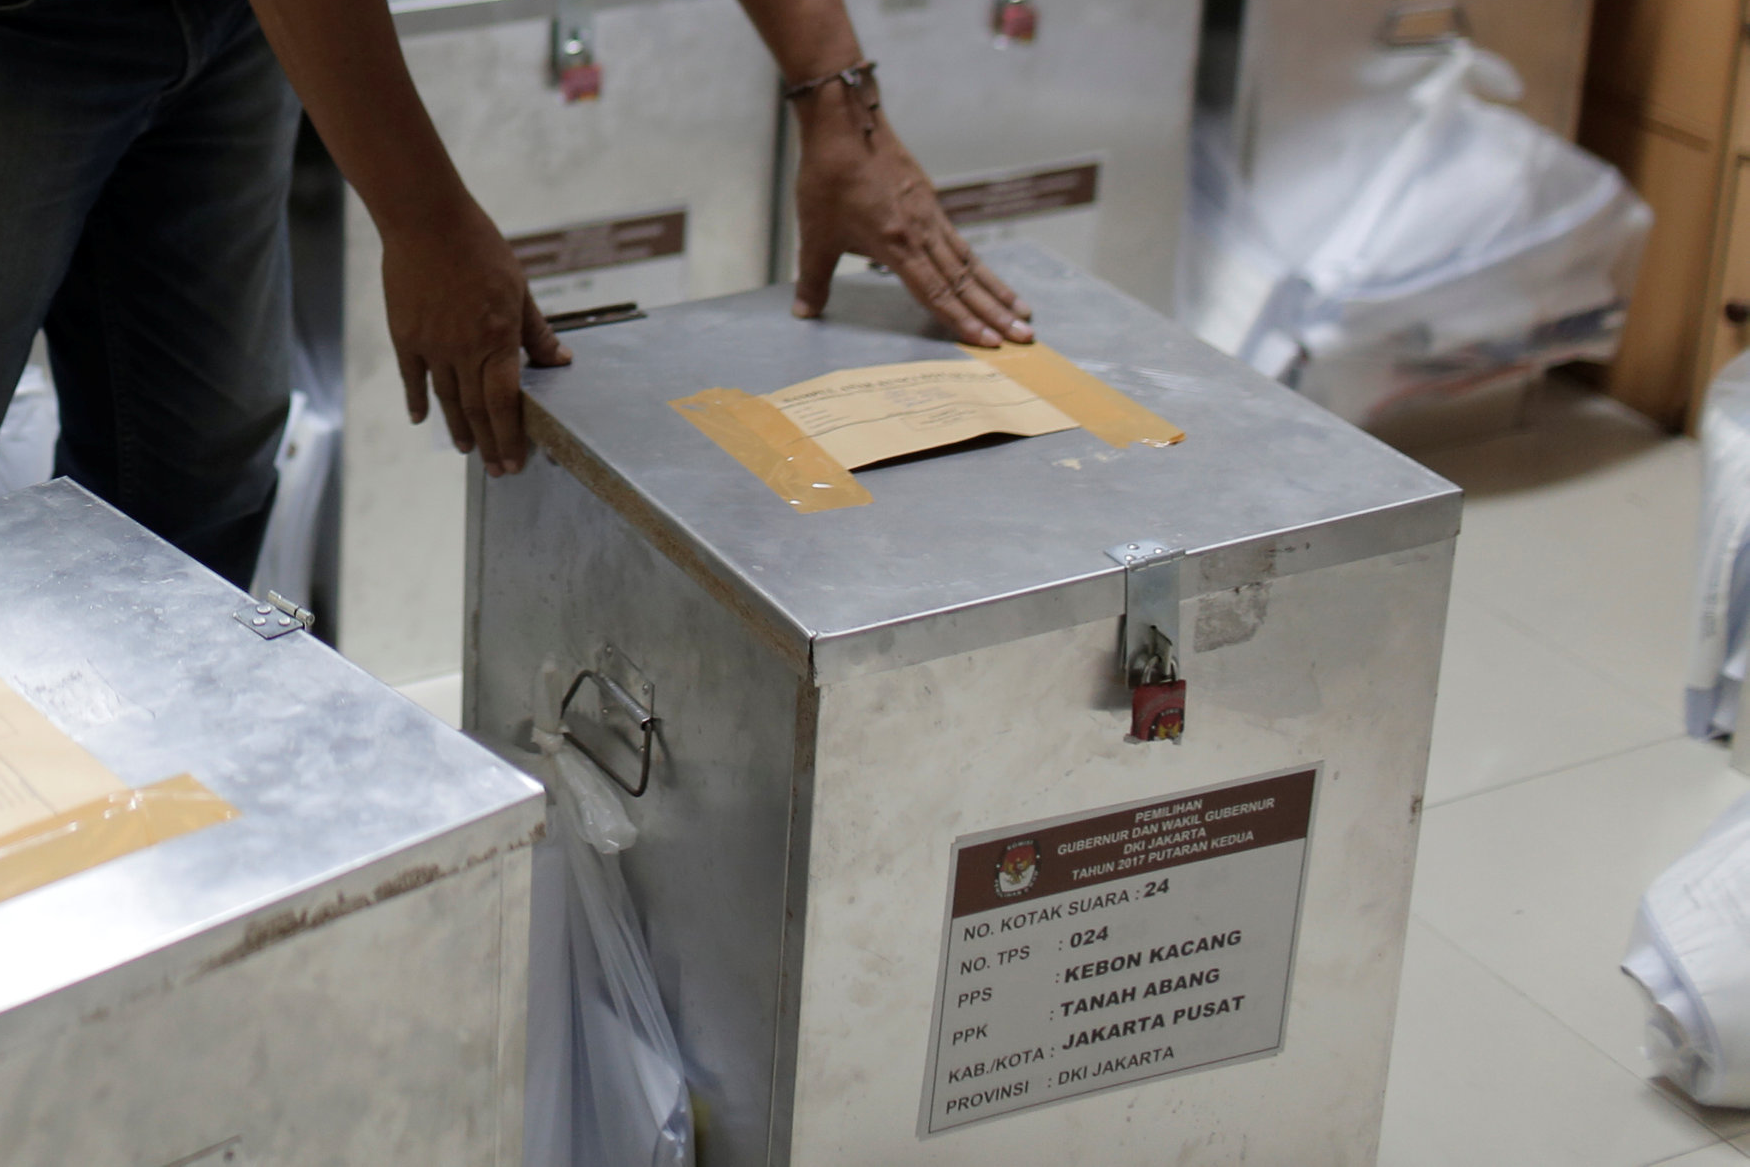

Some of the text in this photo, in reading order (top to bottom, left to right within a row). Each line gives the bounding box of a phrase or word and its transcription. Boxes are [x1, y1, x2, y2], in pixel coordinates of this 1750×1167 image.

[1057, 798, 1275, 855] GUBERNUR DAN WAKIL GUBERNUR
[1123, 827, 1206, 855] DKI JAKARTA
[1135, 799, 1203, 823] PEMILIHAN
[1072, 831, 1254, 881] TAHUN 2017 PUTARAN KEDUA
[963, 922, 994, 942] NO.
[1000, 905, 1062, 933] KOTAK
[1067, 891, 1130, 916] SUARA
[1143, 879, 1170, 899] 24
[958, 987, 992, 1009] PPS
[1064, 952, 1142, 983] KEBON
[1149, 930, 1242, 964] KACANG
[960, 956, 991, 976] NO.
[997, 945, 1030, 966] TPS
[1070, 926, 1109, 948] 024
[952, 1024, 988, 1046] PPK
[1060, 987, 1137, 1018] TANAH
[1143, 968, 1220, 999] ABANG
[948, 1047, 1045, 1084] KAB./KOTA
[1062, 1014, 1166, 1050] JAKARTA
[1172, 995, 1245, 1025] PUSAT
[946, 1081, 1029, 1115] PROVINSI
[1057, 1066, 1088, 1086] DKI
[1092, 1046, 1175, 1077] JAKARTA
